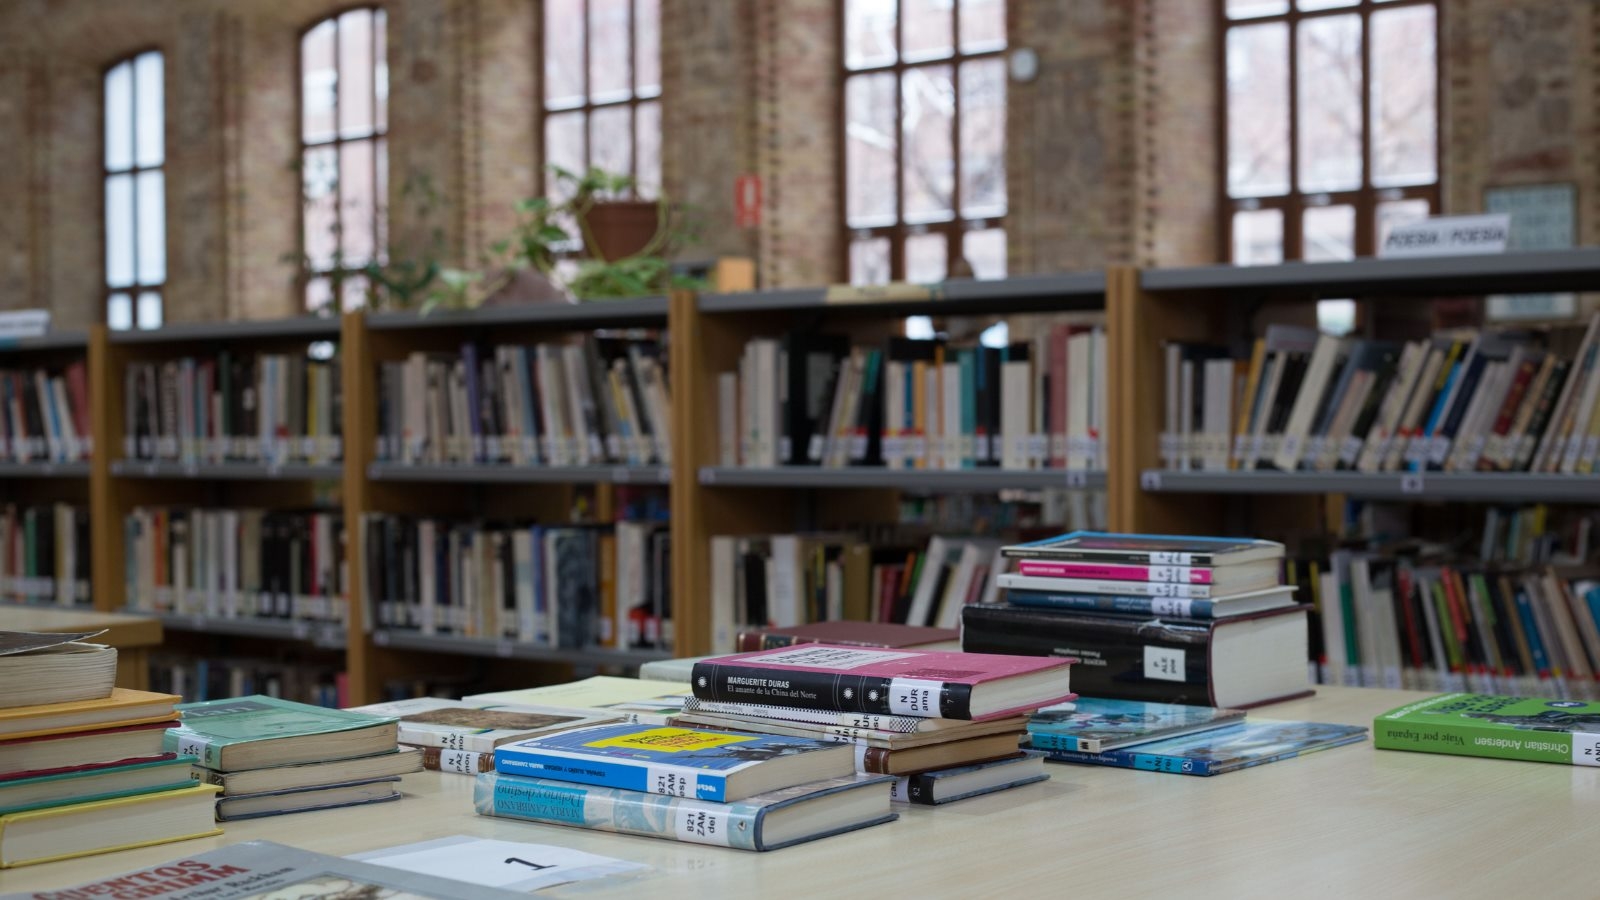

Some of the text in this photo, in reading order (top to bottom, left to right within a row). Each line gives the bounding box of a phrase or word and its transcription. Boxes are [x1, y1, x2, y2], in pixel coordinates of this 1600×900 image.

[727, 676, 790, 689] MARGUERITE DURAS
[727, 685, 734, 693] El
[735, 687, 756, 695] amante
[765, 688, 771, 696] la
[771, 689, 789, 697] China
[790, 690, 799, 698] del
[800, 691, 817, 699] Norte
[901, 695, 908, 703] N
[911, 688, 919, 711] DUR
[1387, 730, 1464, 746] Viaje por España
[1474, 737, 1569, 754] Christian Andersen
[501, 759, 528, 768] ZAMBRANO
[658, 775, 666, 794] 821
[667, 773, 676, 796] ZAM
[497, 784, 536, 803] destino
[543, 791, 581, 808] Delirio
[497, 799, 547, 816] ZAMBRANO
[687, 812, 695, 832] 821
[697, 811, 706, 836] ZAM
[708, 816, 716, 833] del
[504, 856, 558, 871] 1
[32, 860, 211, 900] CUENTOS
[111, 864, 251, 900] GRIMM
